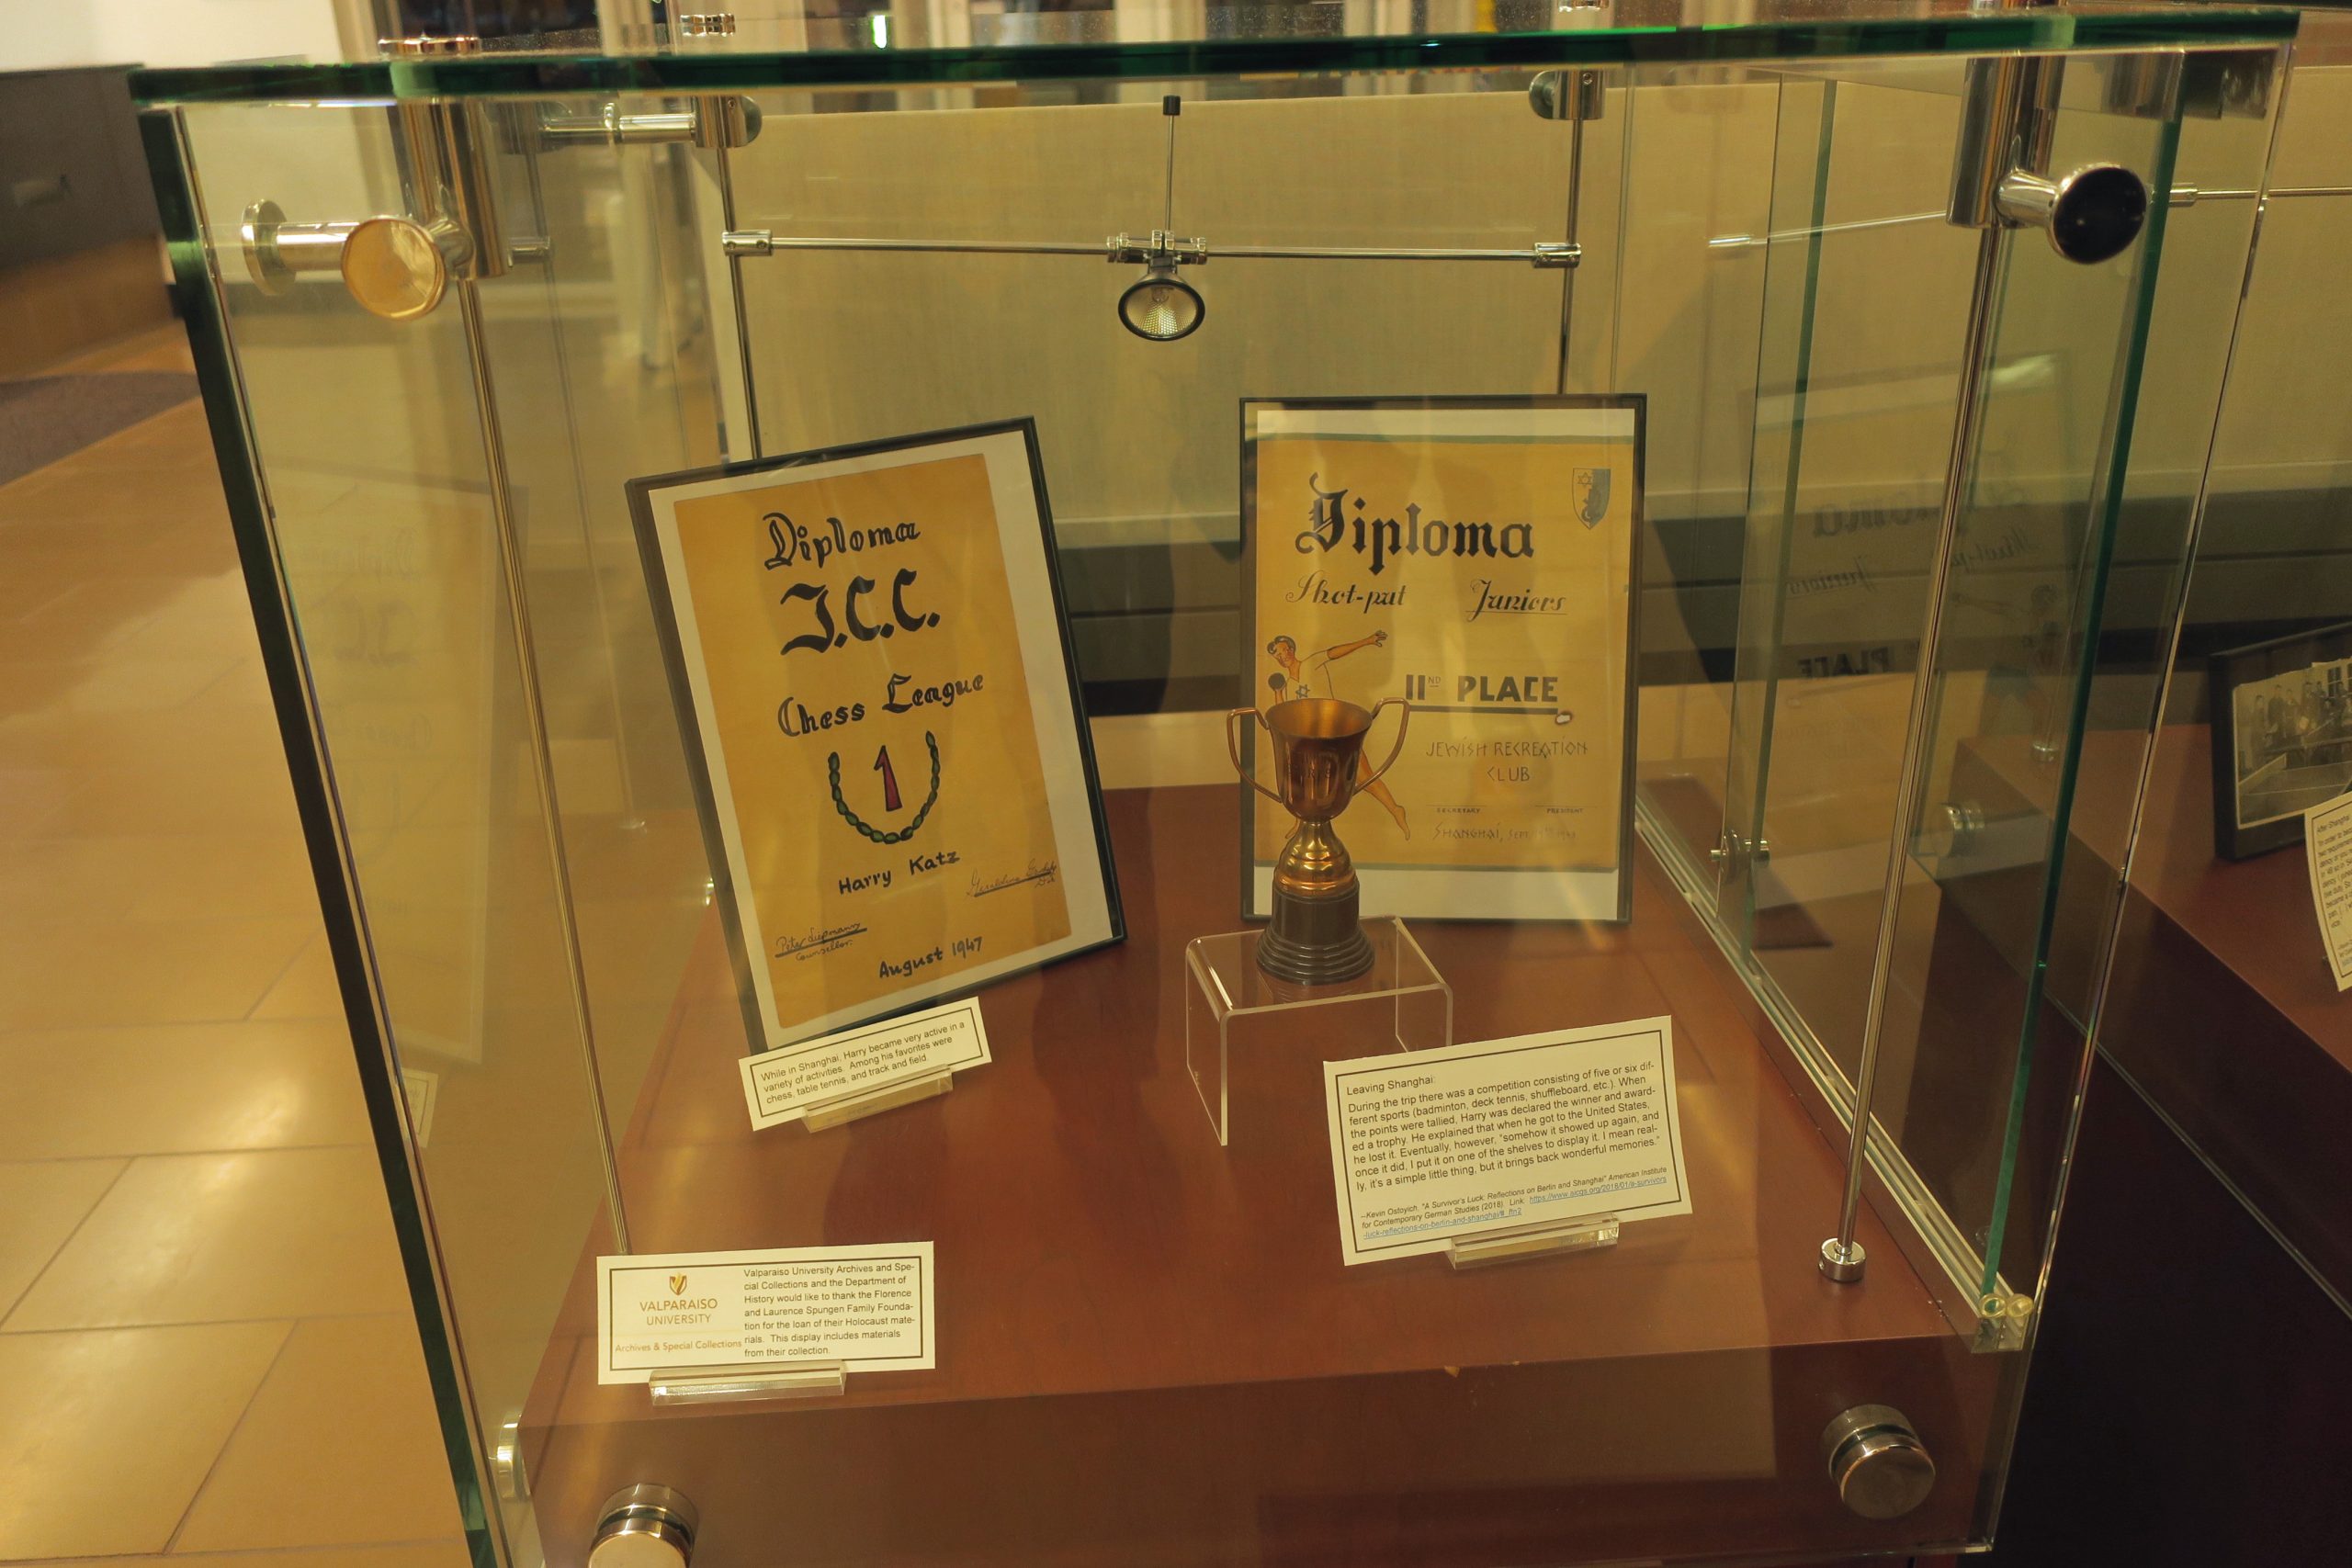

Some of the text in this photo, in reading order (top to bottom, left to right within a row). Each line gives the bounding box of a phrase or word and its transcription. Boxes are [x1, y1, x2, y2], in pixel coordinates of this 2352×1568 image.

[763, 512, 921, 570] Diploma
[1295, 472, 1534, 575] Diploma
[1469, 579, 1566, 623] Juniors
[778, 673, 983, 737] Chess League
[1457, 675, 1558, 703] PLACE
[1426, 737, 1588, 759] JEWISH RECREATION
[874, 745, 902, 811] 1
[1487, 766, 1530, 782] CLUB
[838, 852, 960, 895] Harry Katz
[879, 937, 983, 978] August 1947
[760, 1068, 786, 1081] While
[842, 1048, 866, 1060] Harry
[867, 1038, 902, 1053] became
[903, 1032, 922, 1043] very
[923, 1026, 948, 1038] active
[763, 1036, 953, 1092] variety Among his favorites were
[796, 1084, 819, 1096] table
[851, 1068, 867, 1081] and
[867, 1064, 889, 1077] track
[891, 1058, 908, 1070] and
[1346, 1083, 1385, 1096] Leaving
[1348, 1060, 1655, 1113] During the trip there was competition consisting five six dif-
[1349, 1113, 1378, 1126] ferent
[1380, 1109, 1410, 1122] sports
[1471, 1096, 1495, 1108] deck
[1618, 1076, 1646, 1087] When
[1350, 1128, 1366, 1139] the
[1369, 1123, 1398, 1138] points
[1399, 1121, 1424, 1131] were
[1460, 1111, 1487, 1122] Harry
[1488, 1109, 1509, 1118] was
[1510, 1100, 1551, 1115] declared
[1553, 1100, 1568, 1109] the
[1570, 1095, 1601, 1106] winner
[1604, 1090, 1622, 1101] and
[1623, 1086, 1656, 1099] award-
[1368, 1151, 1386, 1162] lost
[1558, 1120, 1595, 1134] showed
[1642, 1110, 1659, 1122] and
[1428, 1124, 1474, 1141] explained
[1476, 1122, 1495, 1134] that
[1496, 1120, 1522, 1130] when
[1539, 1113, 1555, 1126] got
[1567, 1110, 1583, 1120] the
[1585, 1104, 1615, 1117] United
[1354, 1167, 1379, 1178] once
[1416, 1157, 1432, 1170] put
[1457, 1152, 1476, 1162] one
[1488, 1147, 1505, 1157] the
[1507, 1142, 1543, 1155] shelves
[1556, 1134, 1589, 1147] display
[1608, 1129, 1634, 1139] mean
[1636, 1123, 1657, 1135] real-
[1394, 1171, 1427, 1184] simple
[1428, 1168, 1448, 1179] little
[1479, 1161, 1495, 1171] but
[1505, 1156, 1534, 1168] brings
[1536, 1151, 1559, 1163] back
[1560, 1144, 1607, 1159] wonderful
[743, 1262, 915, 1278] Valparaiso University Archives and Spe-
[743, 1276, 896, 1291] cial Collections and the Department
[639, 1298, 718, 1312] VALPARAISO
[743, 1290, 911, 1304] History would like thank the Florence
[744, 1302, 914, 1317] and Laurence Spungen Family Founda-
[646, 1313, 712, 1325] UNIVERSITY
[744, 1315, 915, 1330] tion for the loan their Holocaust mate-
[769, 1334, 788, 1342] This
[790, 1332, 821, 1343] display
[823, 1331, 859, 1340] includes
[861, 1329, 900, 1338] materials
[615, 1339, 742, 1352] Archives Special Collections
[744, 1348, 764, 1357] from
[766, 1348, 786, 1357] their
